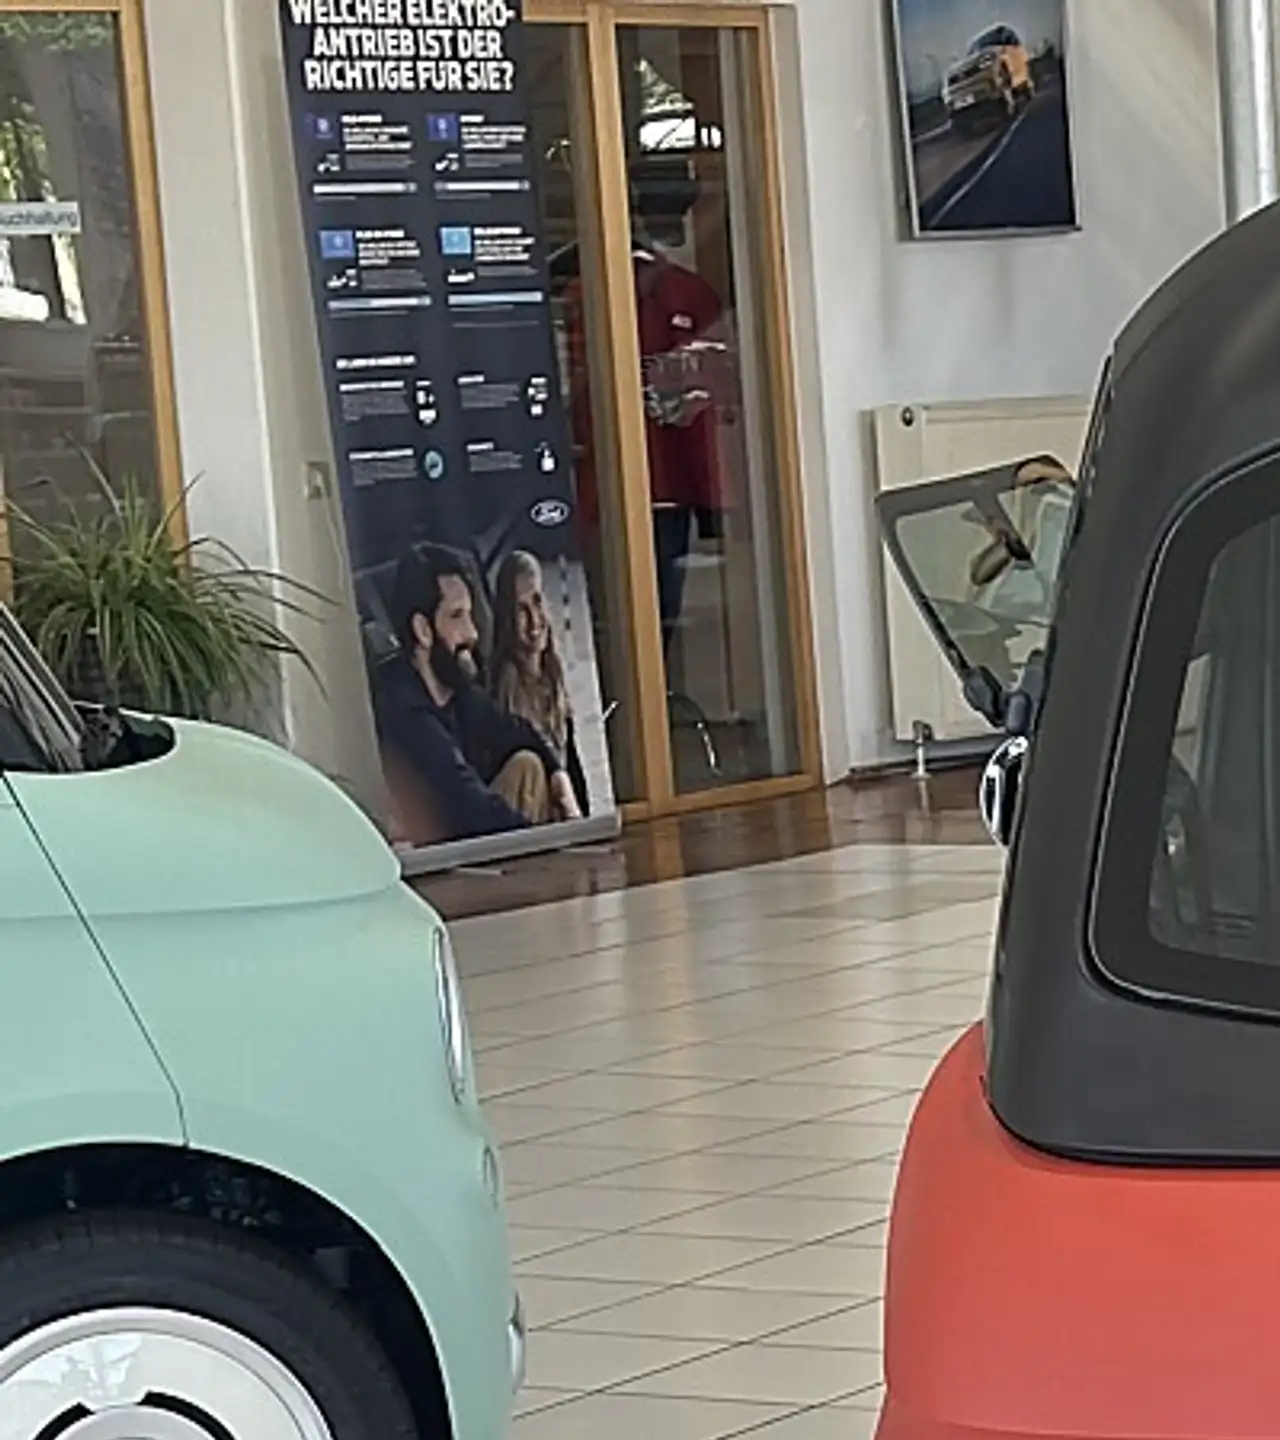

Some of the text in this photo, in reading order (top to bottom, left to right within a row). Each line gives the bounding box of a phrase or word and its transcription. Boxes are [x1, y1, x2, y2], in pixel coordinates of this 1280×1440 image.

[288, 0, 516, 27] WELCHER ELEKTRO-
[313, 26, 503, 58] ANTRIEB IST DER
[303, 59, 416, 91] RICHTIGE
[464, 60, 515, 91] SIE?
